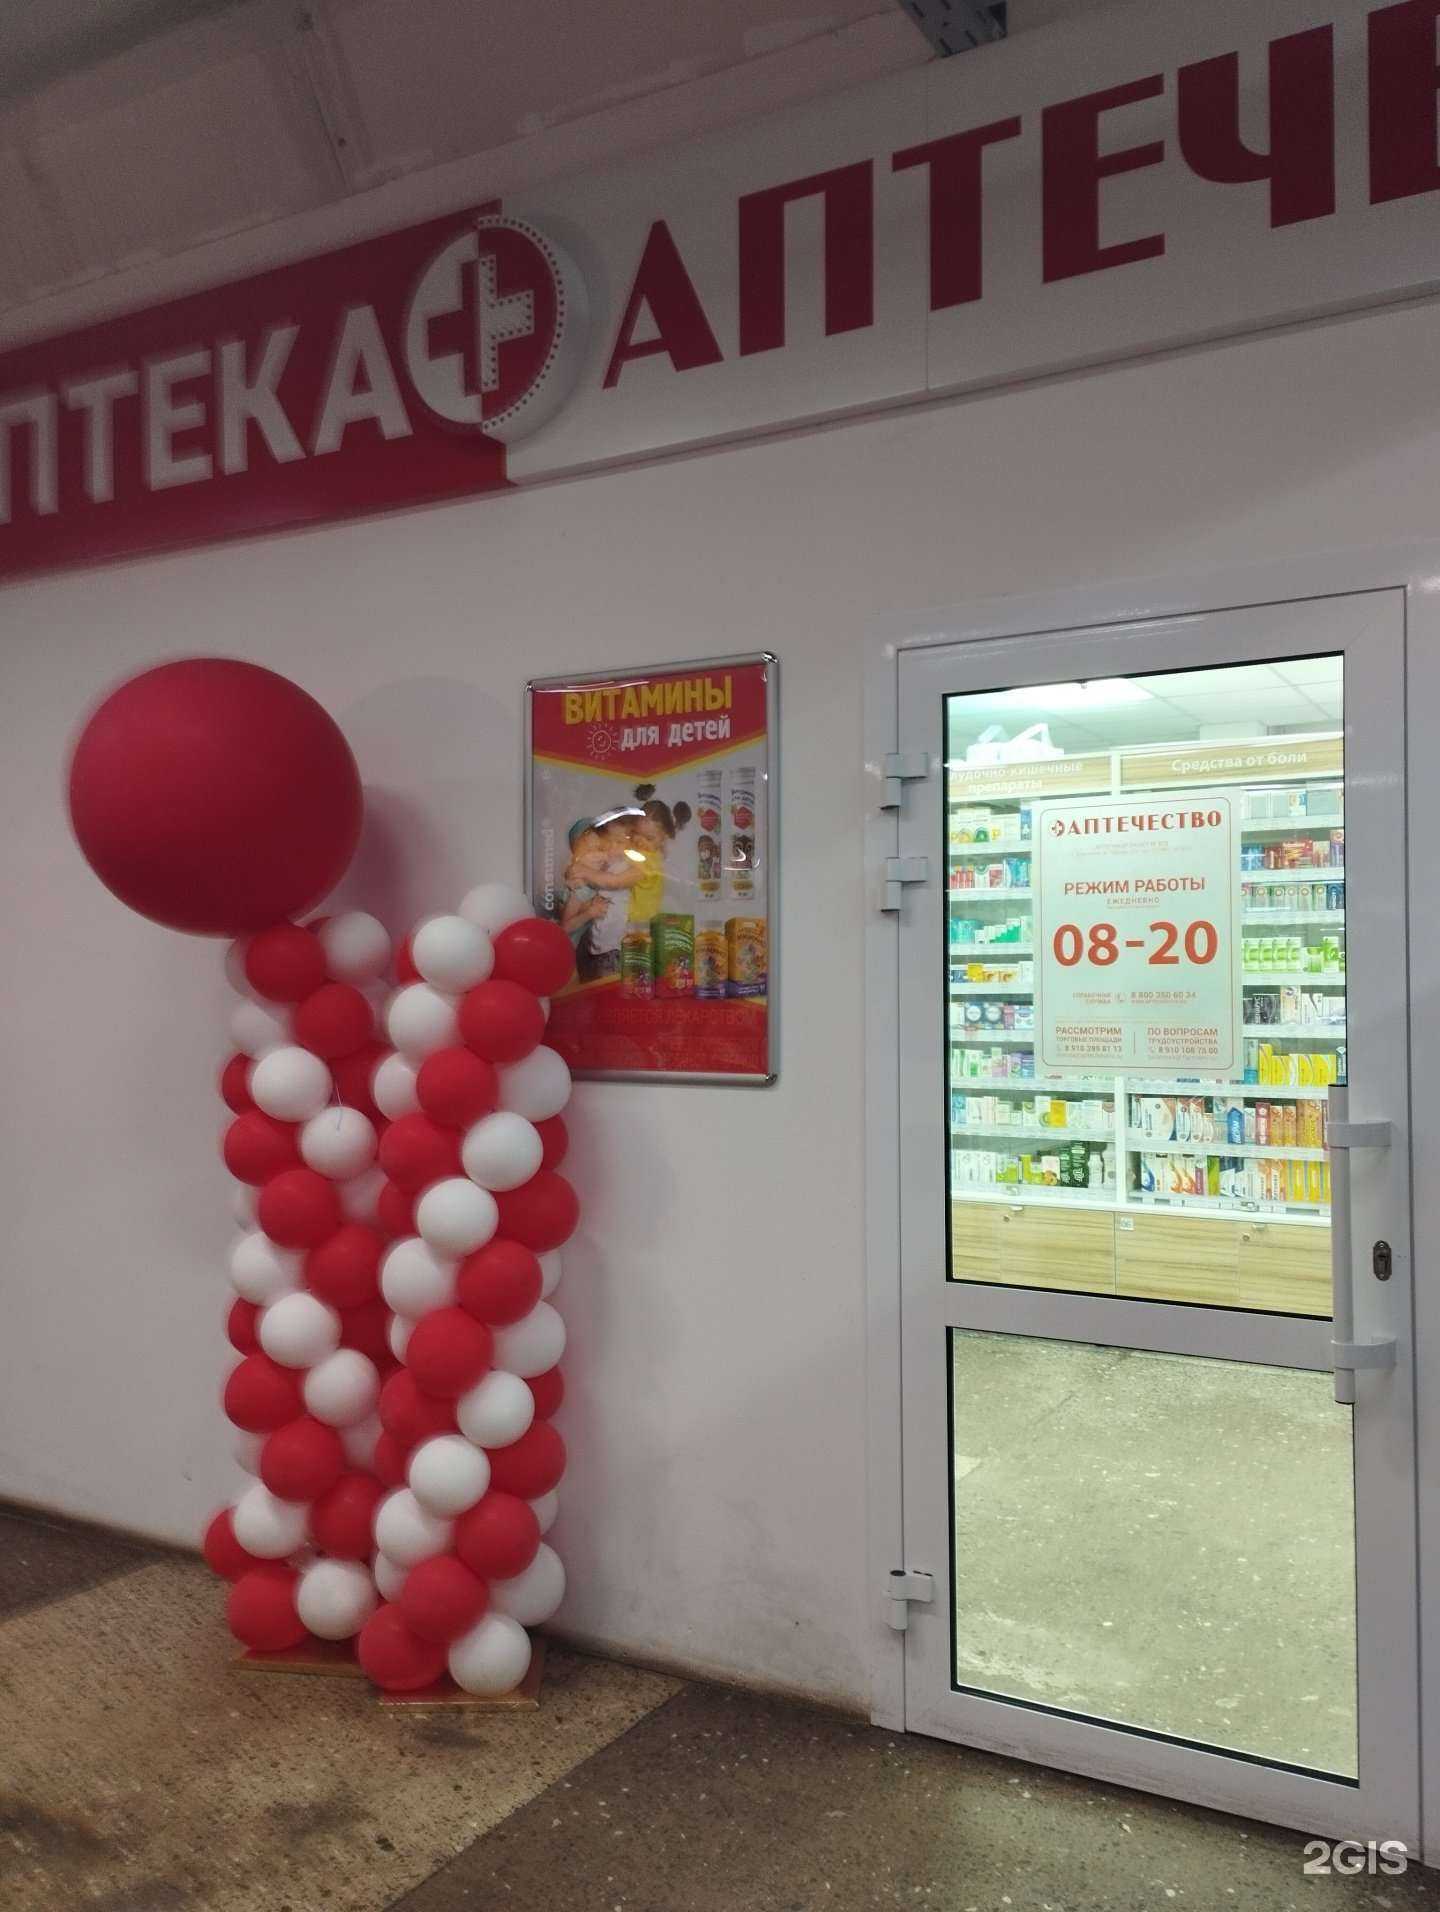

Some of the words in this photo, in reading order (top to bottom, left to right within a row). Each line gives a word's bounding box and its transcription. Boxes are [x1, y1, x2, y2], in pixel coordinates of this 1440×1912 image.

[565, 675, 733, 726] ВИТАМИНЫ
[621, 725, 660, 751] для
[667, 714, 731, 748] детей
[1171, 756, 1243, 775] Средства
[1246, 755, 1264, 766] от
[1267, 750, 1307, 766] боли
[1068, 810, 1222, 836] АПТЕЧЕСТВО
[1064, 880, 1130, 896] РЕЖИМ
[1134, 877, 1206, 893] РАБОТЫ
[1053, 920, 1219, 967] 08-20
[1055, 1026, 1122, 1036] РАССМОТРИМ
[1147, 1027, 1161, 1037] ПО
[1163, 1027, 1218, 1037] ВОПРОСАМ
